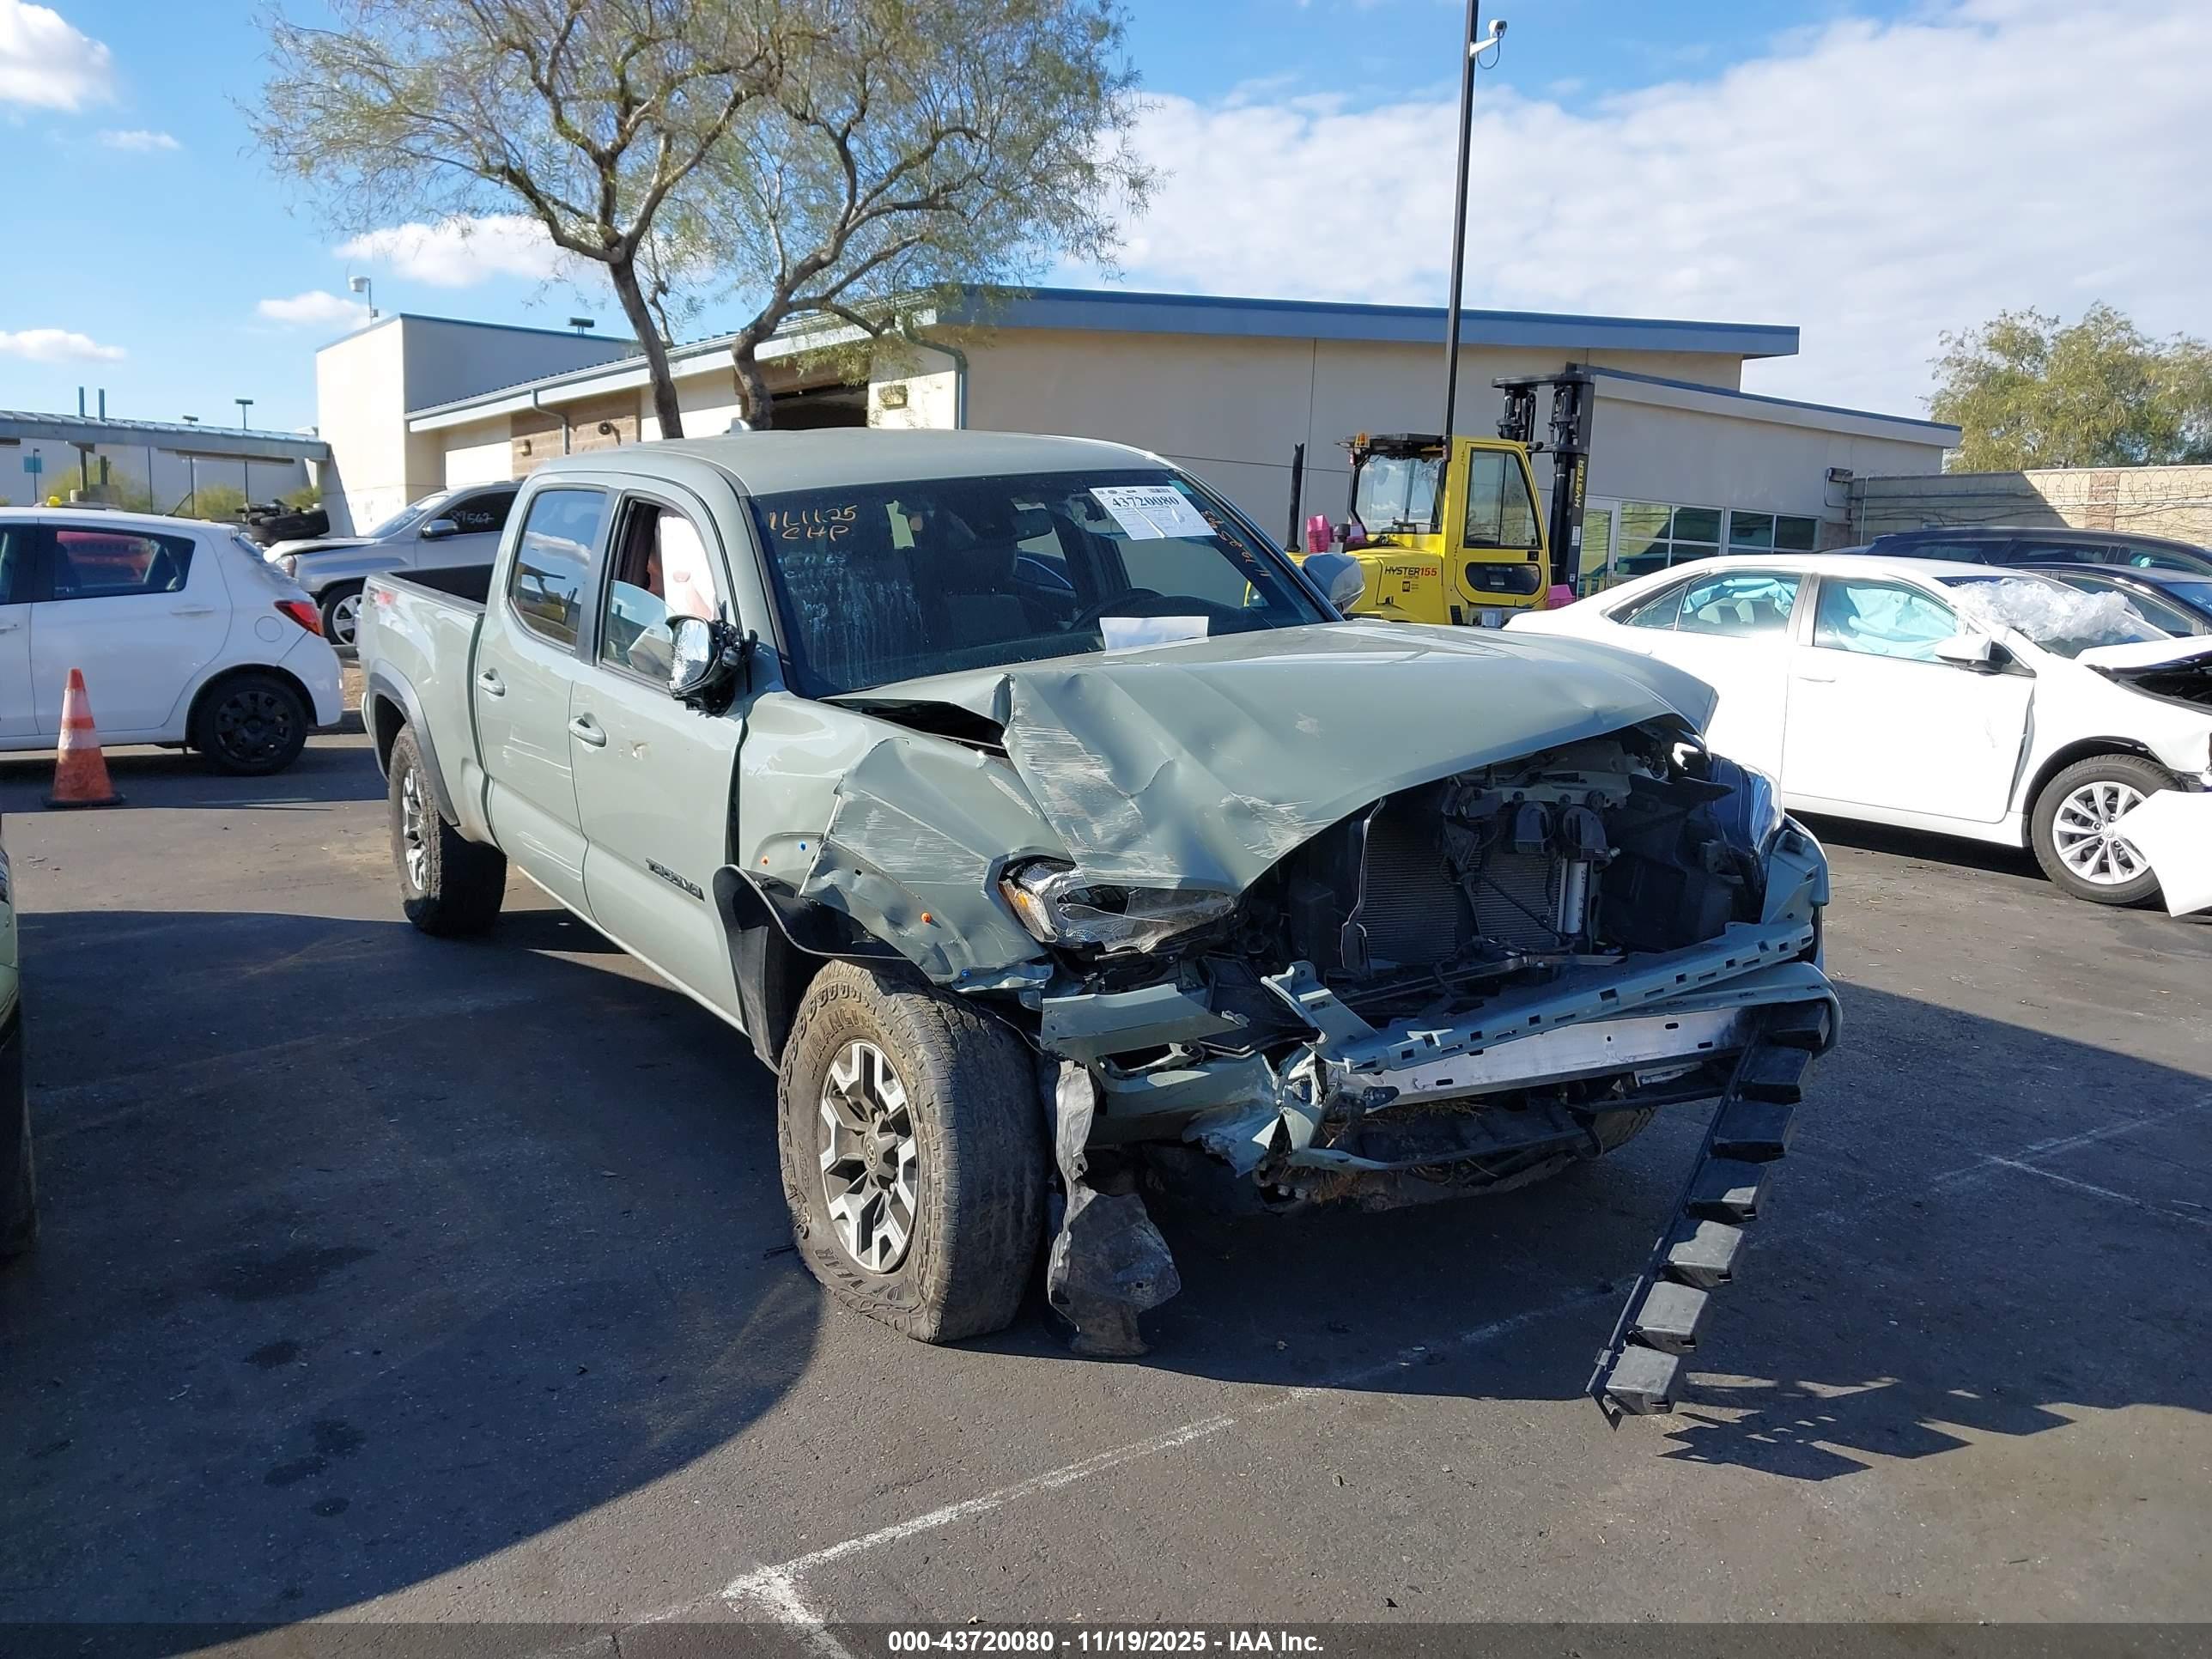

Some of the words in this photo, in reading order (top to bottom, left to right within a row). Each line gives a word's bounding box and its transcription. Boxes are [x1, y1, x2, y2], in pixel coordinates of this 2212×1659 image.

[1112, 495, 1180, 507] 43720080
[1574, 459, 1585, 508] HYSTER
[645, 857, 705, 902] TACOMA
